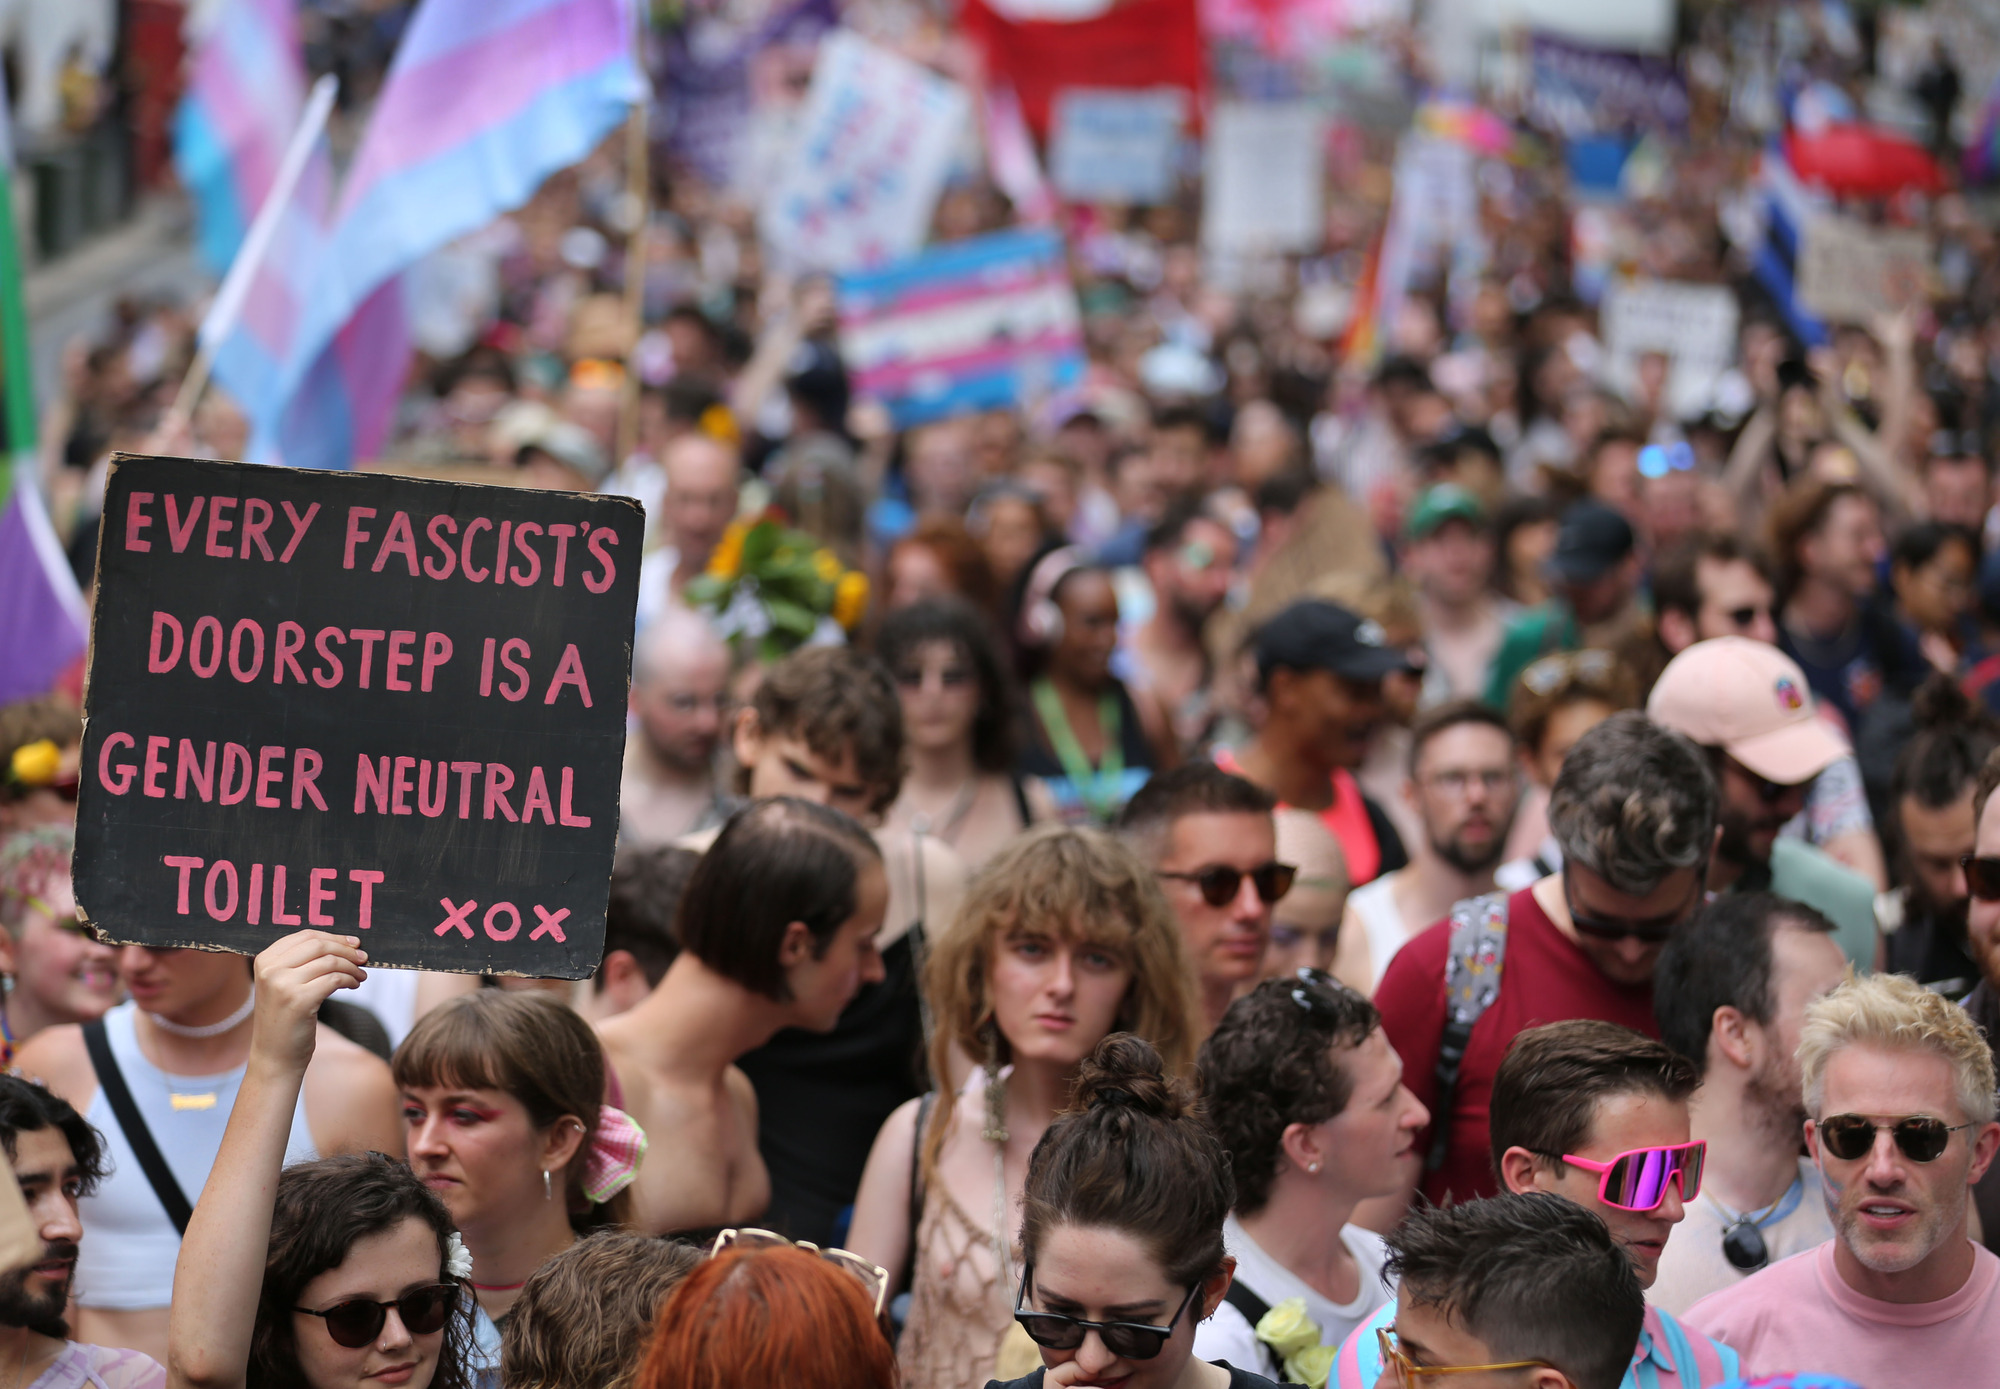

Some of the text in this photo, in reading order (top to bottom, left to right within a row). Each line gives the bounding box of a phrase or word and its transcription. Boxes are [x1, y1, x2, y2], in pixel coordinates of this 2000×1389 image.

[125, 491, 620, 594] EVERY FASCIST'S
[147, 610, 594, 709] DOORSTEP IS A
[98, 731, 592, 829] GENDER NEUTRAL
[163, 854, 386, 930] TOILET
